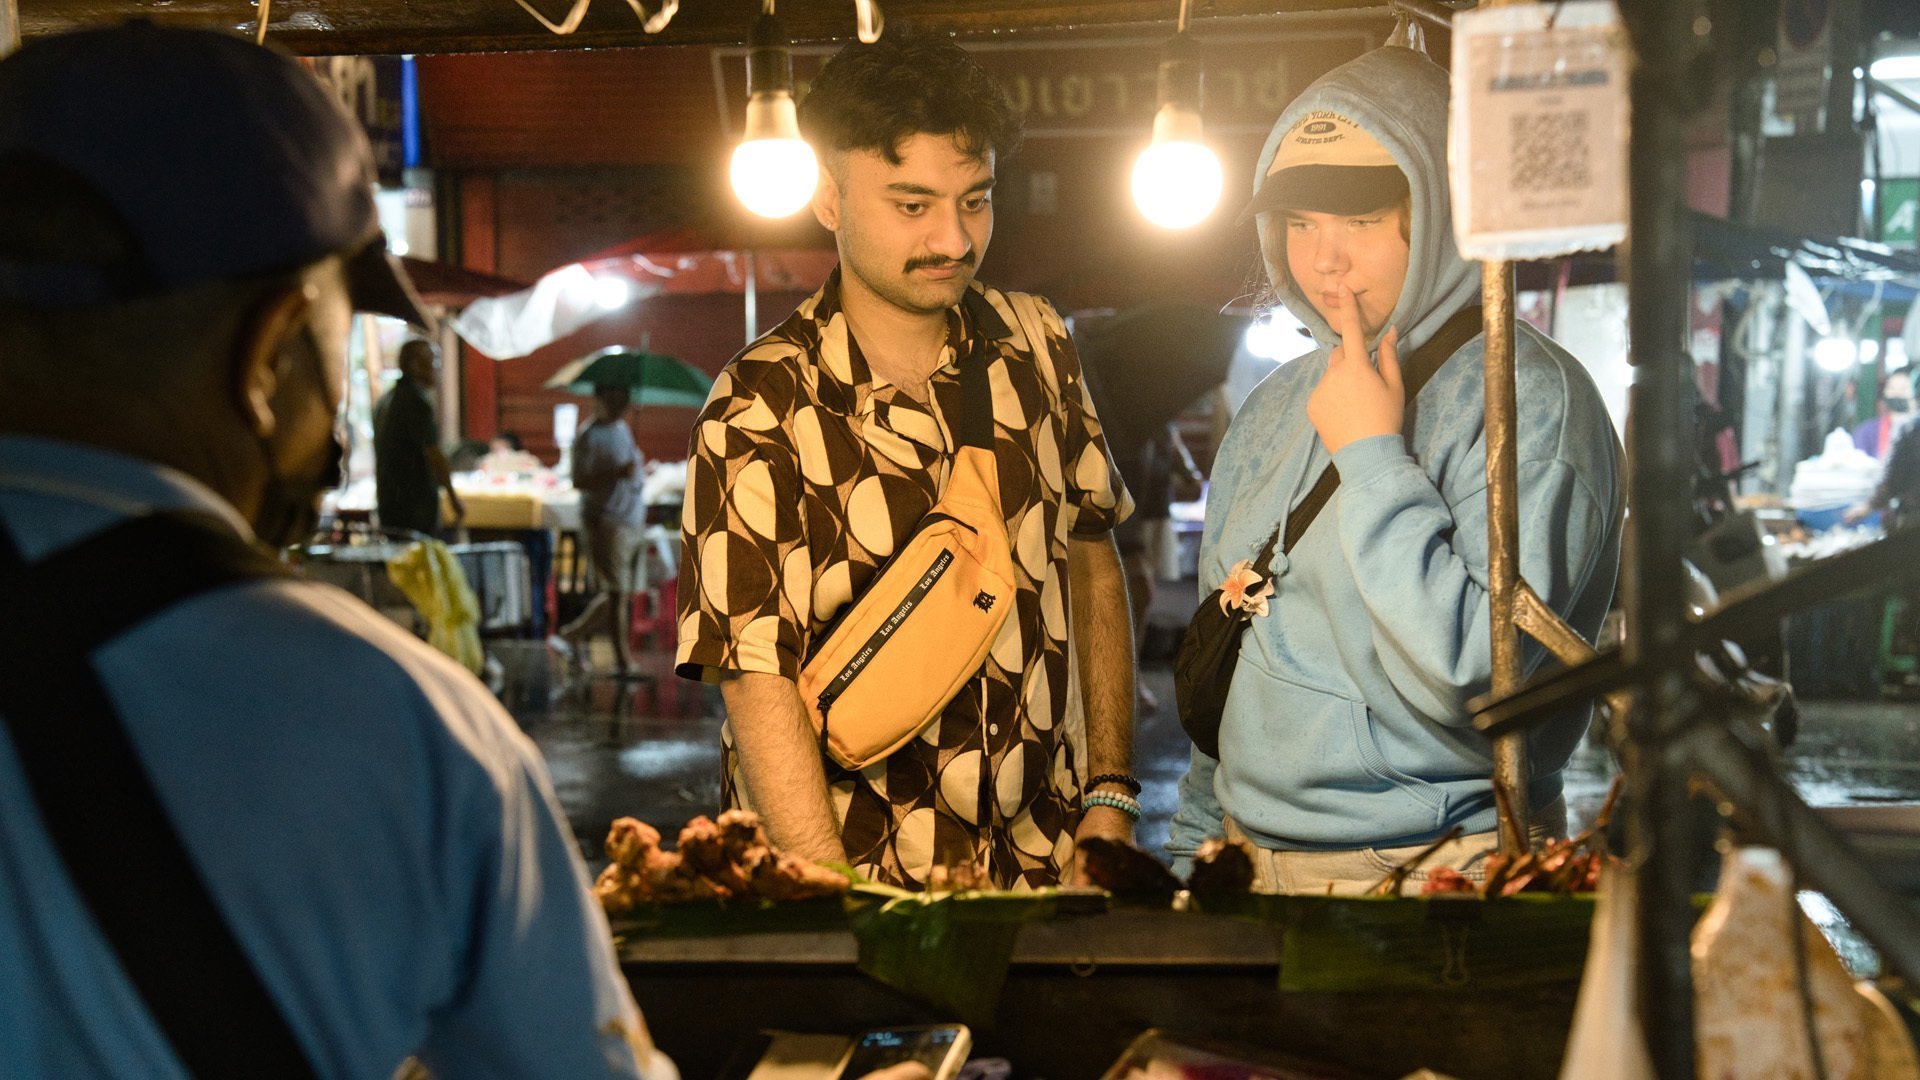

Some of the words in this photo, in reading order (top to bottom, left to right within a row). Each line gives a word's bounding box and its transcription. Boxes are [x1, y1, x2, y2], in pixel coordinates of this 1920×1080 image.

[919, 578, 932, 590] Los
[930, 554, 950, 577] Angeles
[879, 624, 893, 637] Los
[891, 601, 913, 625] Angeles
[839, 670, 853, 682] Los
[850, 647, 873, 670] Angeles
